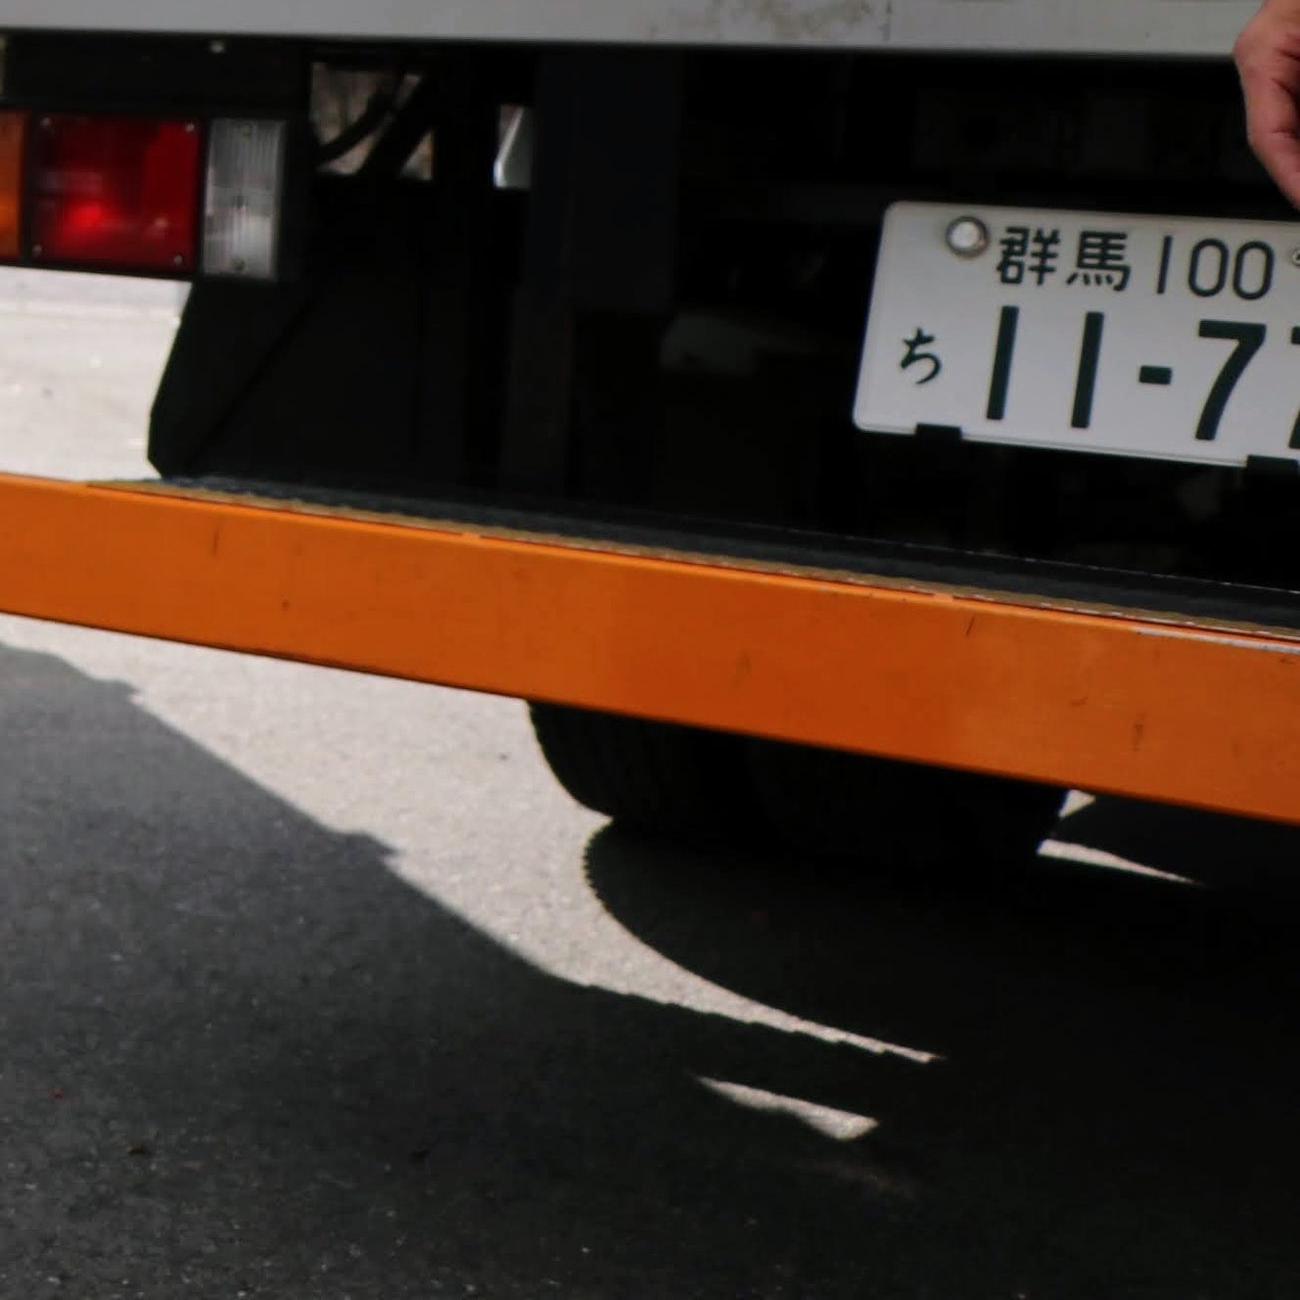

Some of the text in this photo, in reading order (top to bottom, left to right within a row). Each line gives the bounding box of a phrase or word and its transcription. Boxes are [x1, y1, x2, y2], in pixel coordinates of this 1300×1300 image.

[997, 226, 1275, 300] 群馬 100
[899, 305, 1300, 450] ち 11-7
